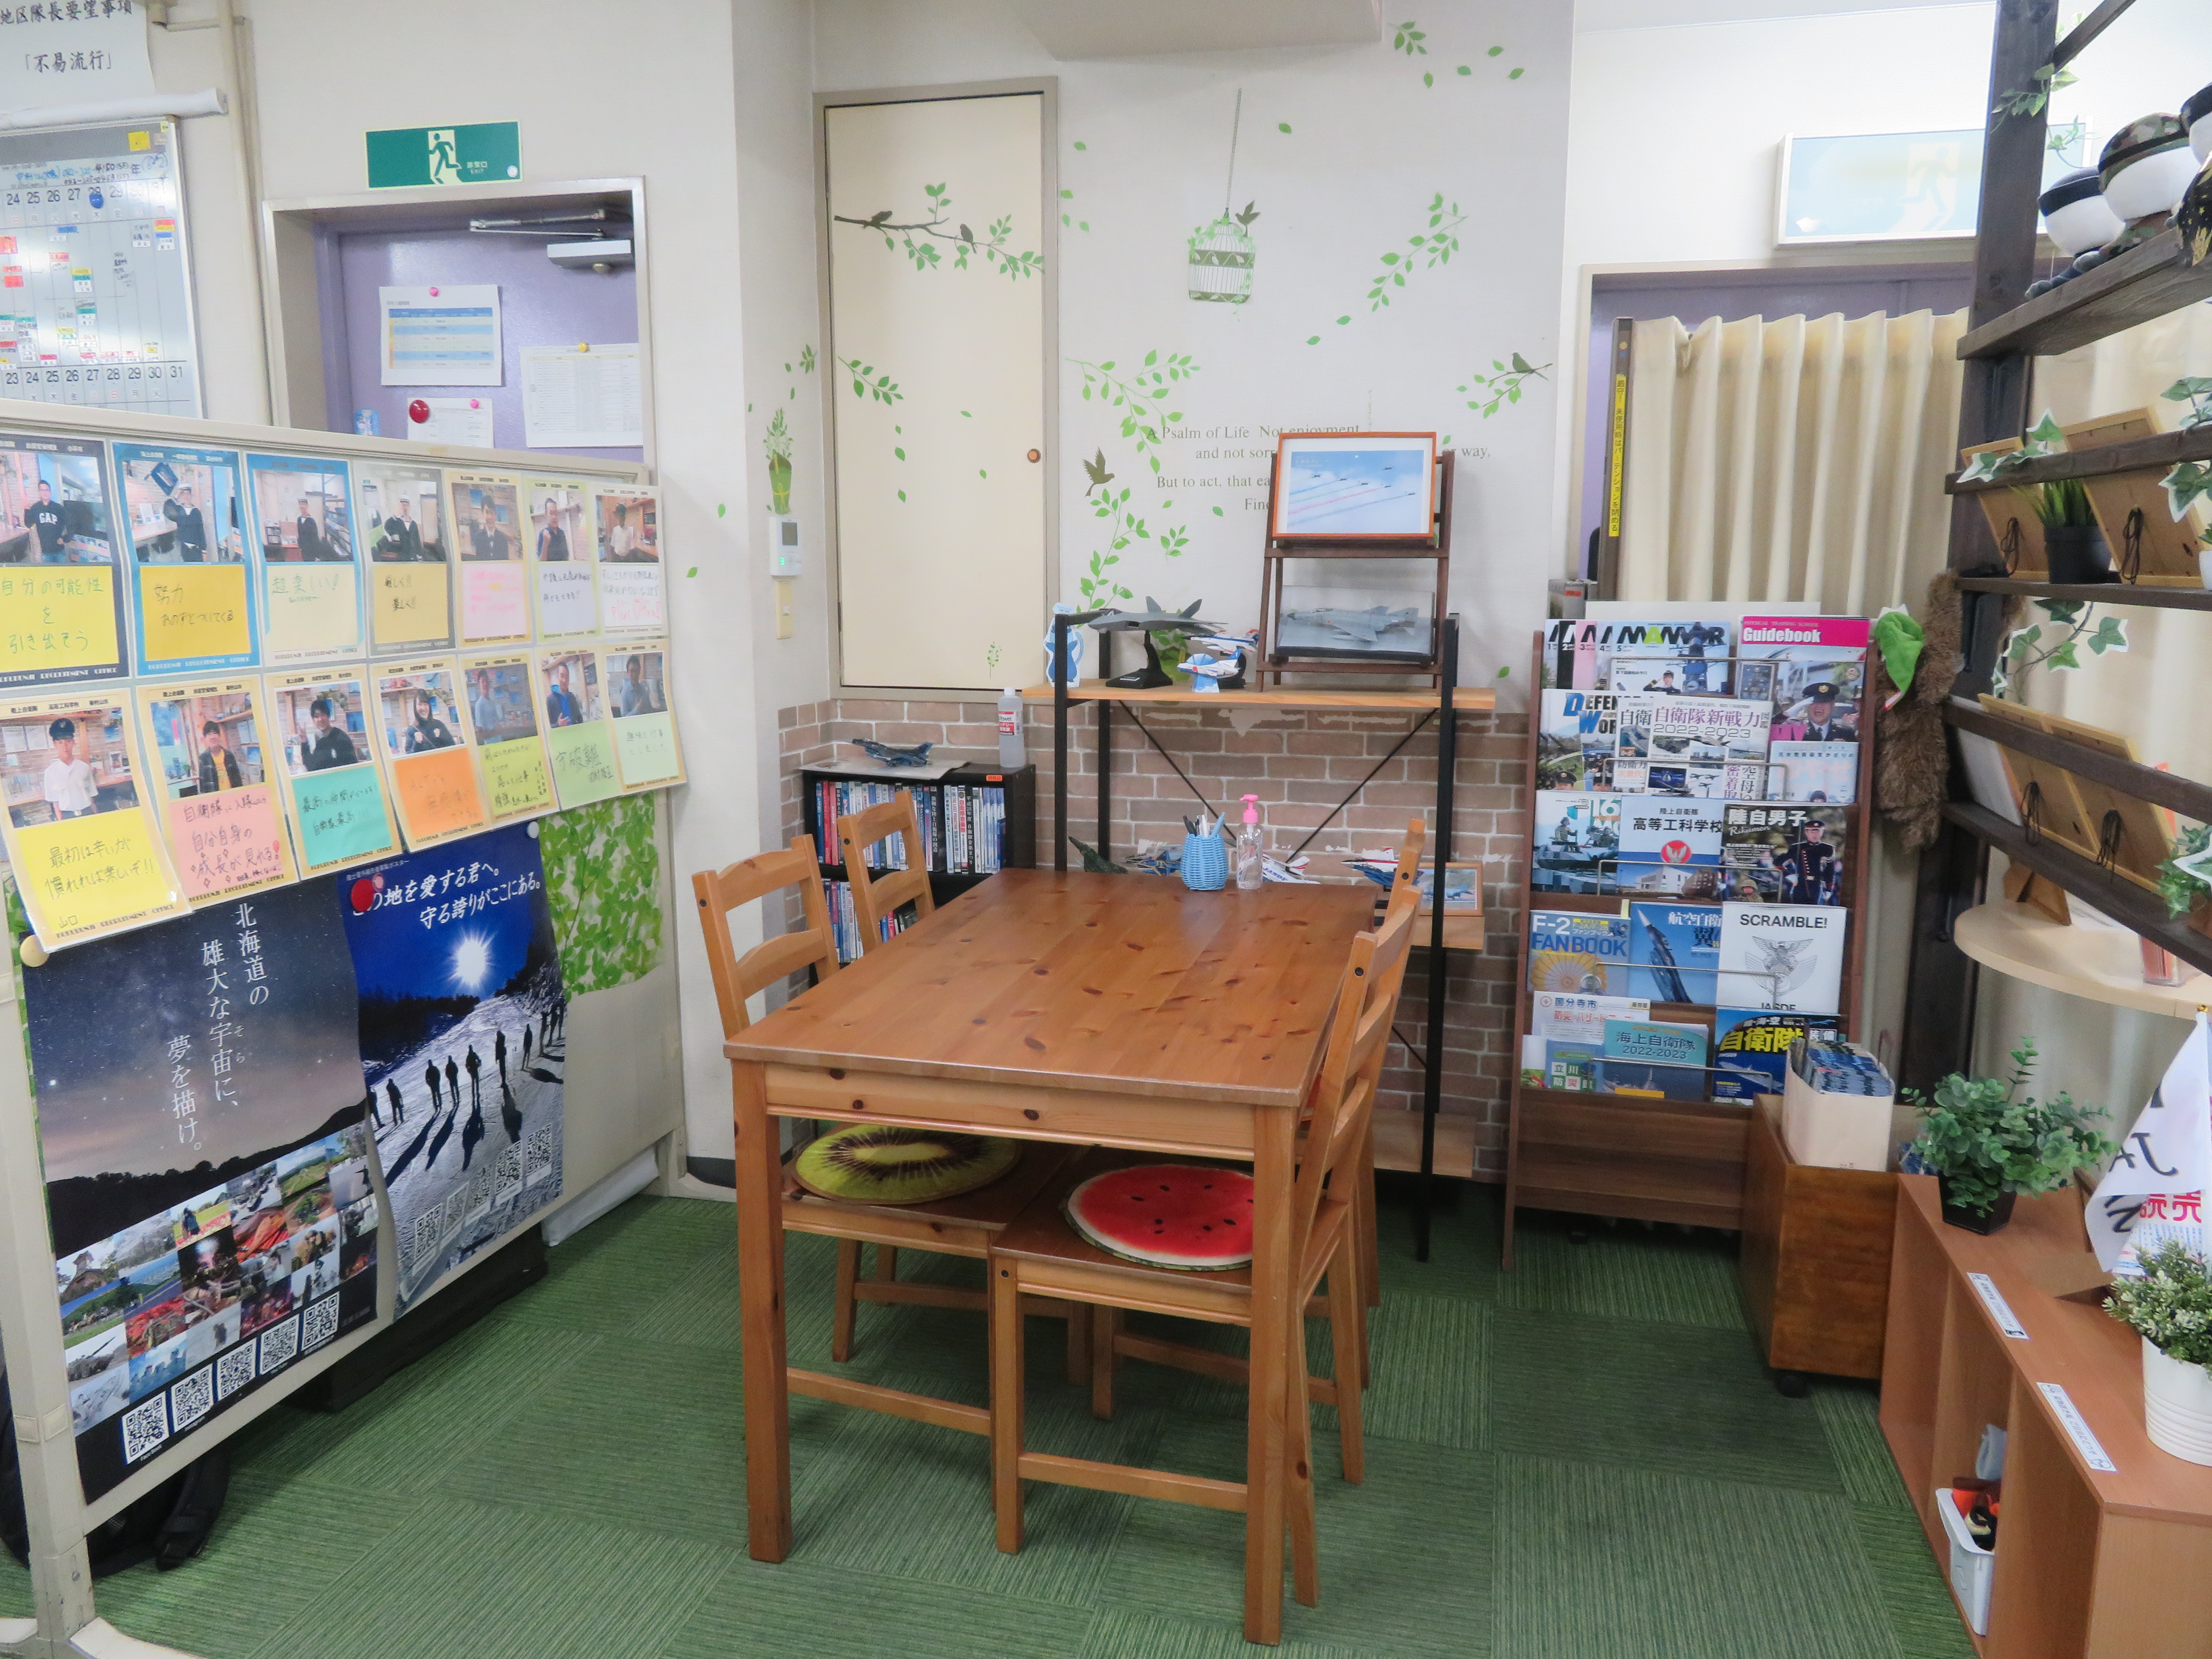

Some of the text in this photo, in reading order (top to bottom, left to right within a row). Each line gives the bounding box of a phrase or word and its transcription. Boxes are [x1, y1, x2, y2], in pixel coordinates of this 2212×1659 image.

[25, 50, 112, 73] 「不易流行」
[7, 194, 20, 205] 24
[27, 192, 41, 204] 25
[47, 190, 61, 202] 26
[68, 188, 80, 201] 27
[6, 366, 183, 384] 23 24 25 26 27 28 29 30 31
[1147, 428, 1158, 439] A
[1162, 427, 1201, 439] Psalm
[1206, 427, 1220, 439] of
[1224, 427, 1250, 439] Life
[1196, 448, 1218, 459] and
[1224, 448, 1245, 458] not
[1249, 449, 1278, 458] sorr
[1157, 476, 1177, 487] But
[1183, 478, 1195, 487] to
[1227, 476, 1252, 487] that
[1257, 477, 1270, 487] ea
[2, 577, 104, 597] 自分の可能性
[43, 607, 55, 624] を
[9, 630, 88, 654] 引き出そう
[1743, 627, 1821, 643] Guidebook
[1620, 709, 1653, 726] 自衛
[1655, 707, 1760, 727] 自衛隊新戦力
[1653, 724, 1752, 739] 2022-2023
[1633, 818, 1722, 833] 高等工科学校
[1729, 809, 1807, 827] 陸自男子
[49, 838, 131, 868] 最初は辛いが
[1263, 867, 1288, 881] JASDF
[353, 862, 499, 916] の地を愛する君へ。
[420, 872, 540, 929] 守る誇りがここにある。
[58, 915, 78, 928] 山口
[1532, 914, 1571, 935] F-2
[1740, 914, 1828, 929] SCRAMBLE!
[236, 903, 269, 1006] 北海道の
[1555, 998, 1597, 1010] 国分寺市
[201, 940, 239, 1106] 雄大な宇宙に、
[1617, 1031, 1696, 1051] 海上自衛隊
[1623, 1045, 1686, 1059] 2022-2023
[168, 1034, 203, 1151] 夢を描け。
